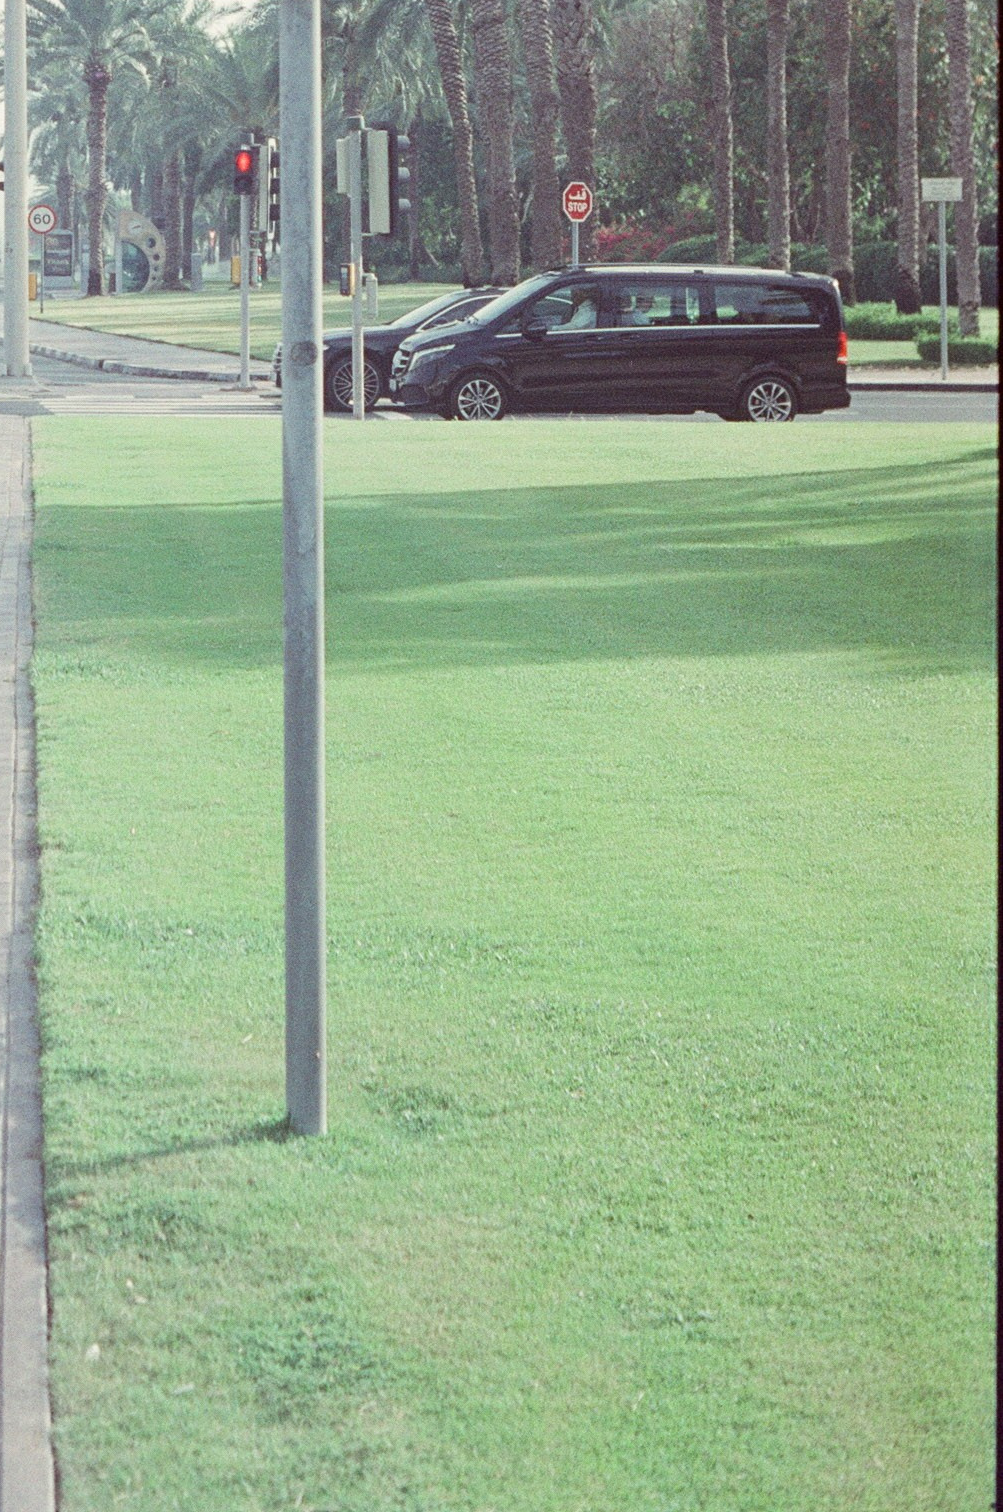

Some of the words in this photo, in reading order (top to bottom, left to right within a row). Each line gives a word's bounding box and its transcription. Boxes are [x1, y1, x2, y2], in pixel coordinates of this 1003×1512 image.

[568, 188, 587, 201] قف
[567, 201, 588, 213] STOP
[33, 214, 51, 225] 60
